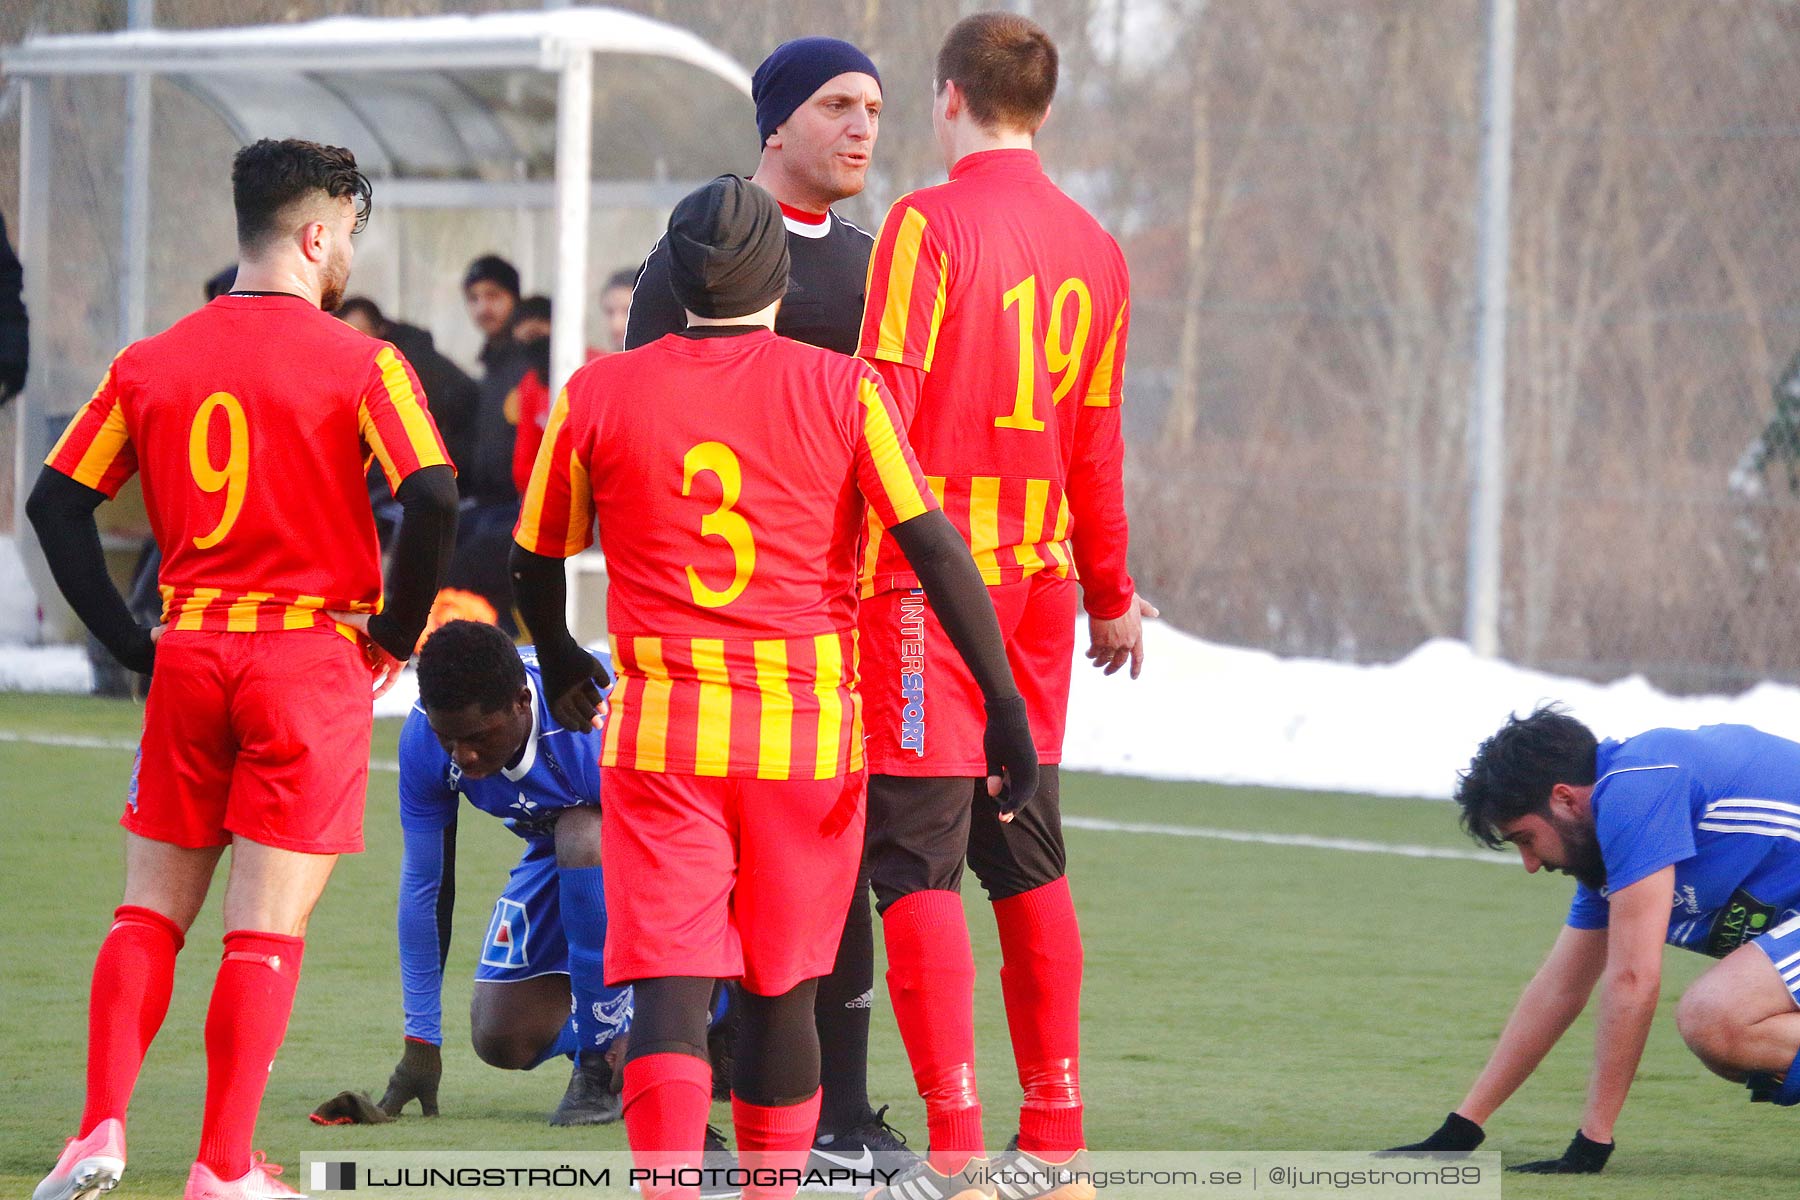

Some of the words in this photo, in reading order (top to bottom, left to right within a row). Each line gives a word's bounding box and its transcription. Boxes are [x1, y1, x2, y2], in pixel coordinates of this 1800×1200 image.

[994, 274, 1093, 433] 19
[189, 390, 249, 550] 9
[682, 441, 756, 608] 3
[900, 596, 925, 756] INTERSPORT
